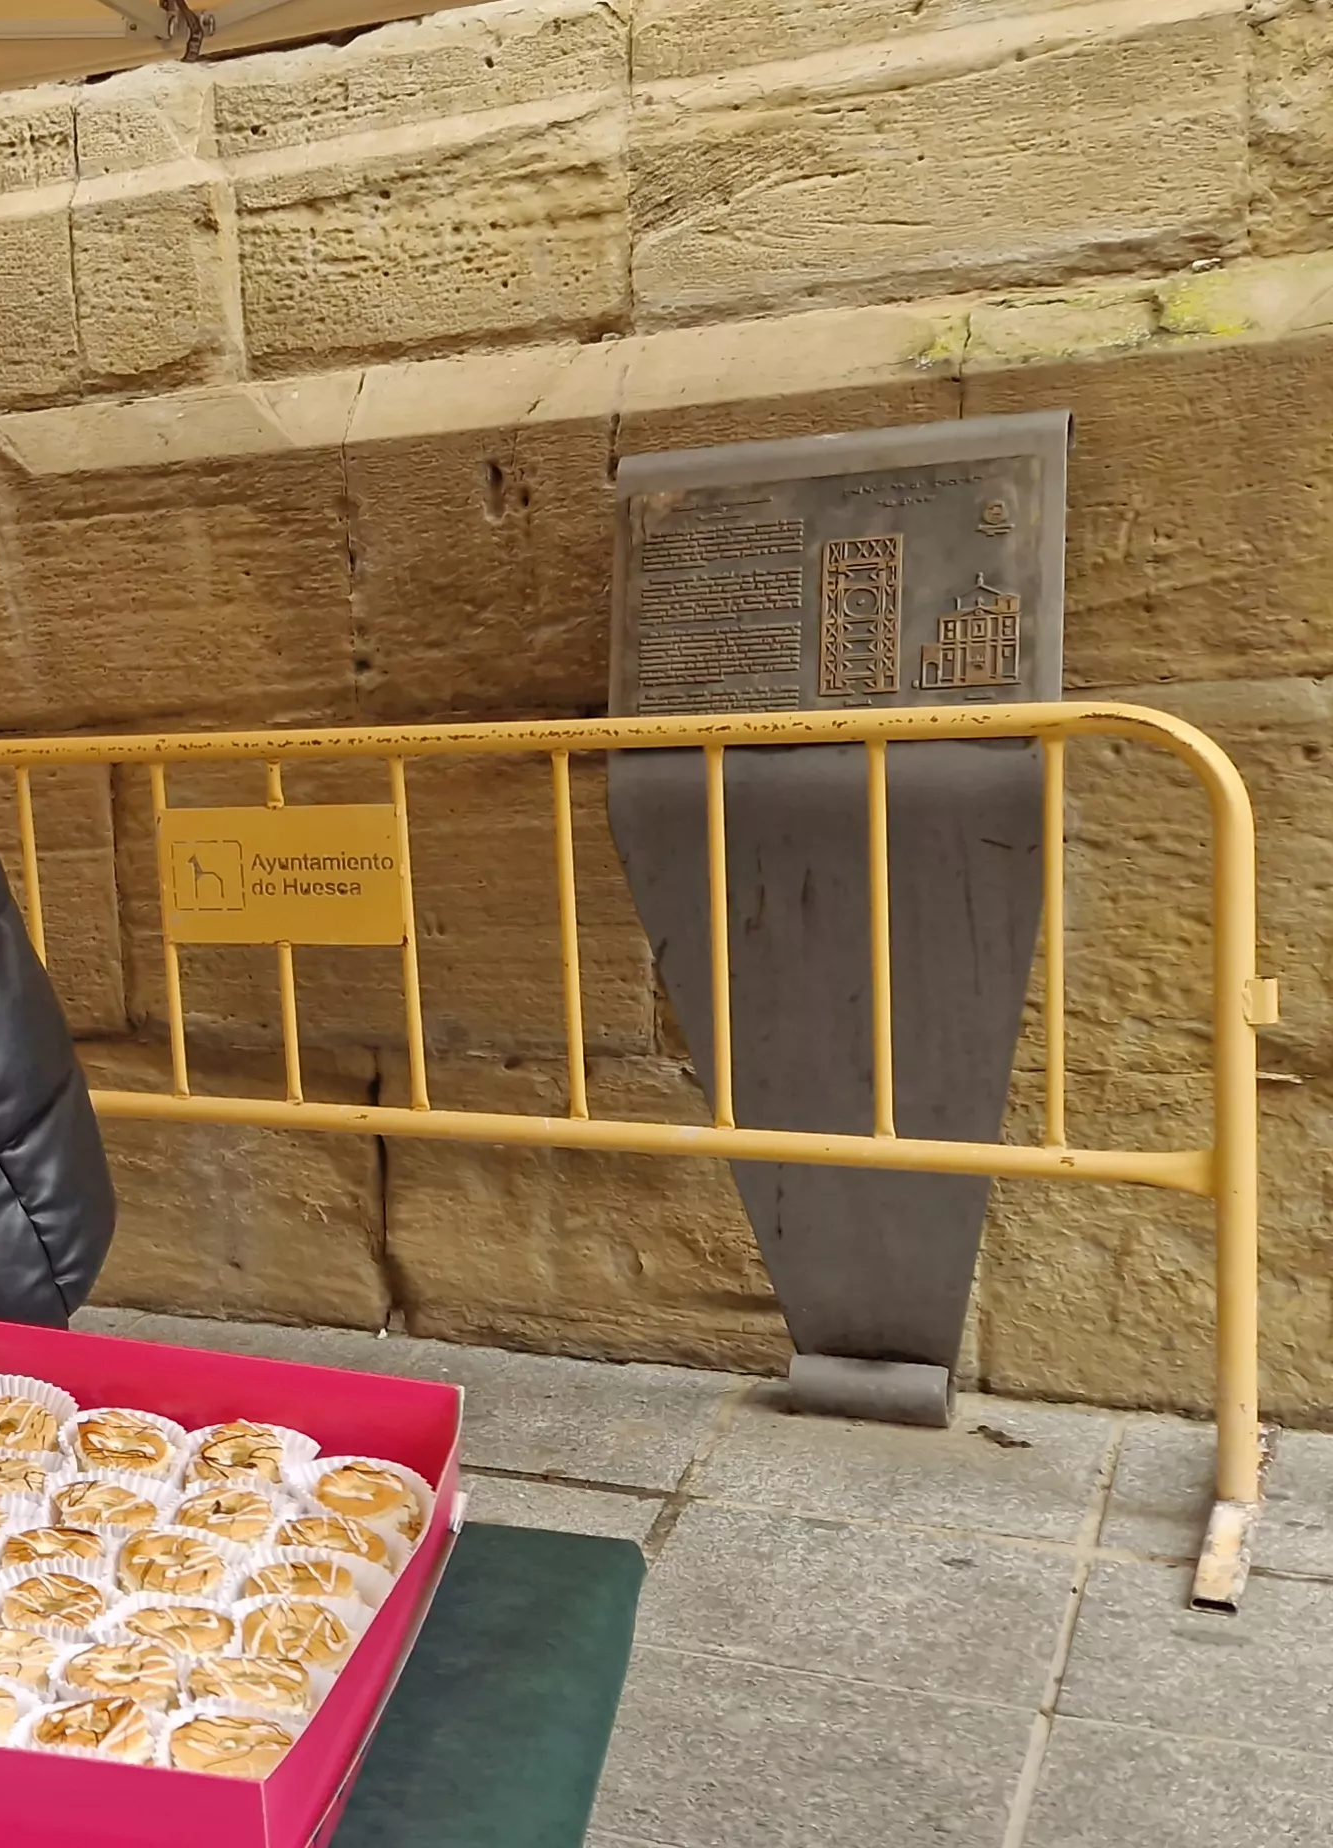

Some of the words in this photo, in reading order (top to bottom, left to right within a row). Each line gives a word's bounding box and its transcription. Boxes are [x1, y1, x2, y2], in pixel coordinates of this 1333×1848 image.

[251, 852, 394, 875] Ayuntamiento
[252, 878, 276, 896] de
[283, 877, 361, 896] Huesca
